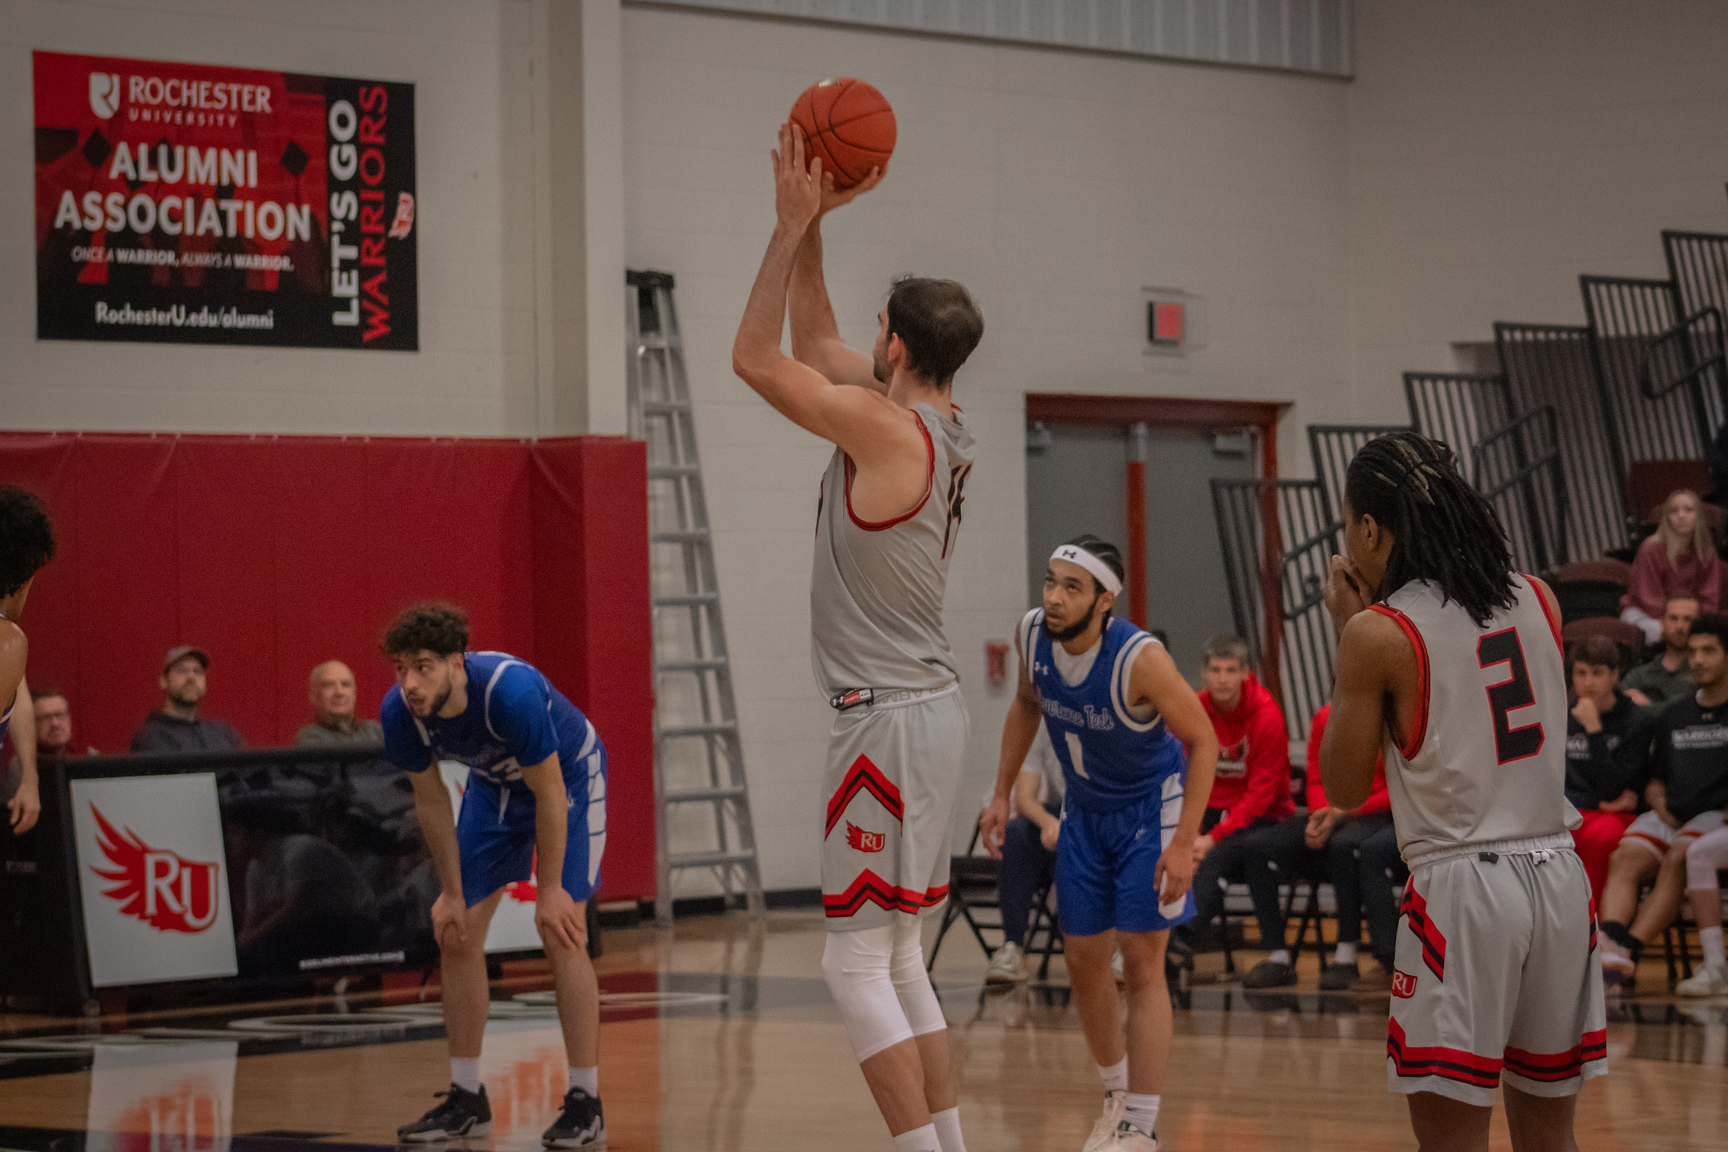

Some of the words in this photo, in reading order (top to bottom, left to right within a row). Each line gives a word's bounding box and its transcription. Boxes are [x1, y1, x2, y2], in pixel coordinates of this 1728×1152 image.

[129, 75, 272, 114] ROCHESTER
[129, 109, 237, 128] UNIVERSITY
[329, 99, 358, 181] GO
[109, 141, 258, 188] ALUMNI
[54, 190, 311, 241] ASSOCIATION
[359, 85, 391, 343] WARRIORS
[71, 245, 106, 263] ONCE
[106, 248, 115, 263] A
[115, 248, 180, 267] WARRIOR,
[181, 252, 223, 268] ALWAYS
[223, 253, 233, 268] A
[233, 254, 295, 271] WARRIOR.
[329, 189, 360, 326] LET'S
[95, 301, 274, 330] RochesterU.edu/alumni
[1083, 704, 1114, 731] Tech
[1475, 626, 1546, 766] 2
[1064, 730, 1090, 781] 1
[861, 833, 884, 850] RU
[144, 852, 219, 929] RU
[1392, 972, 1417, 996] RU
